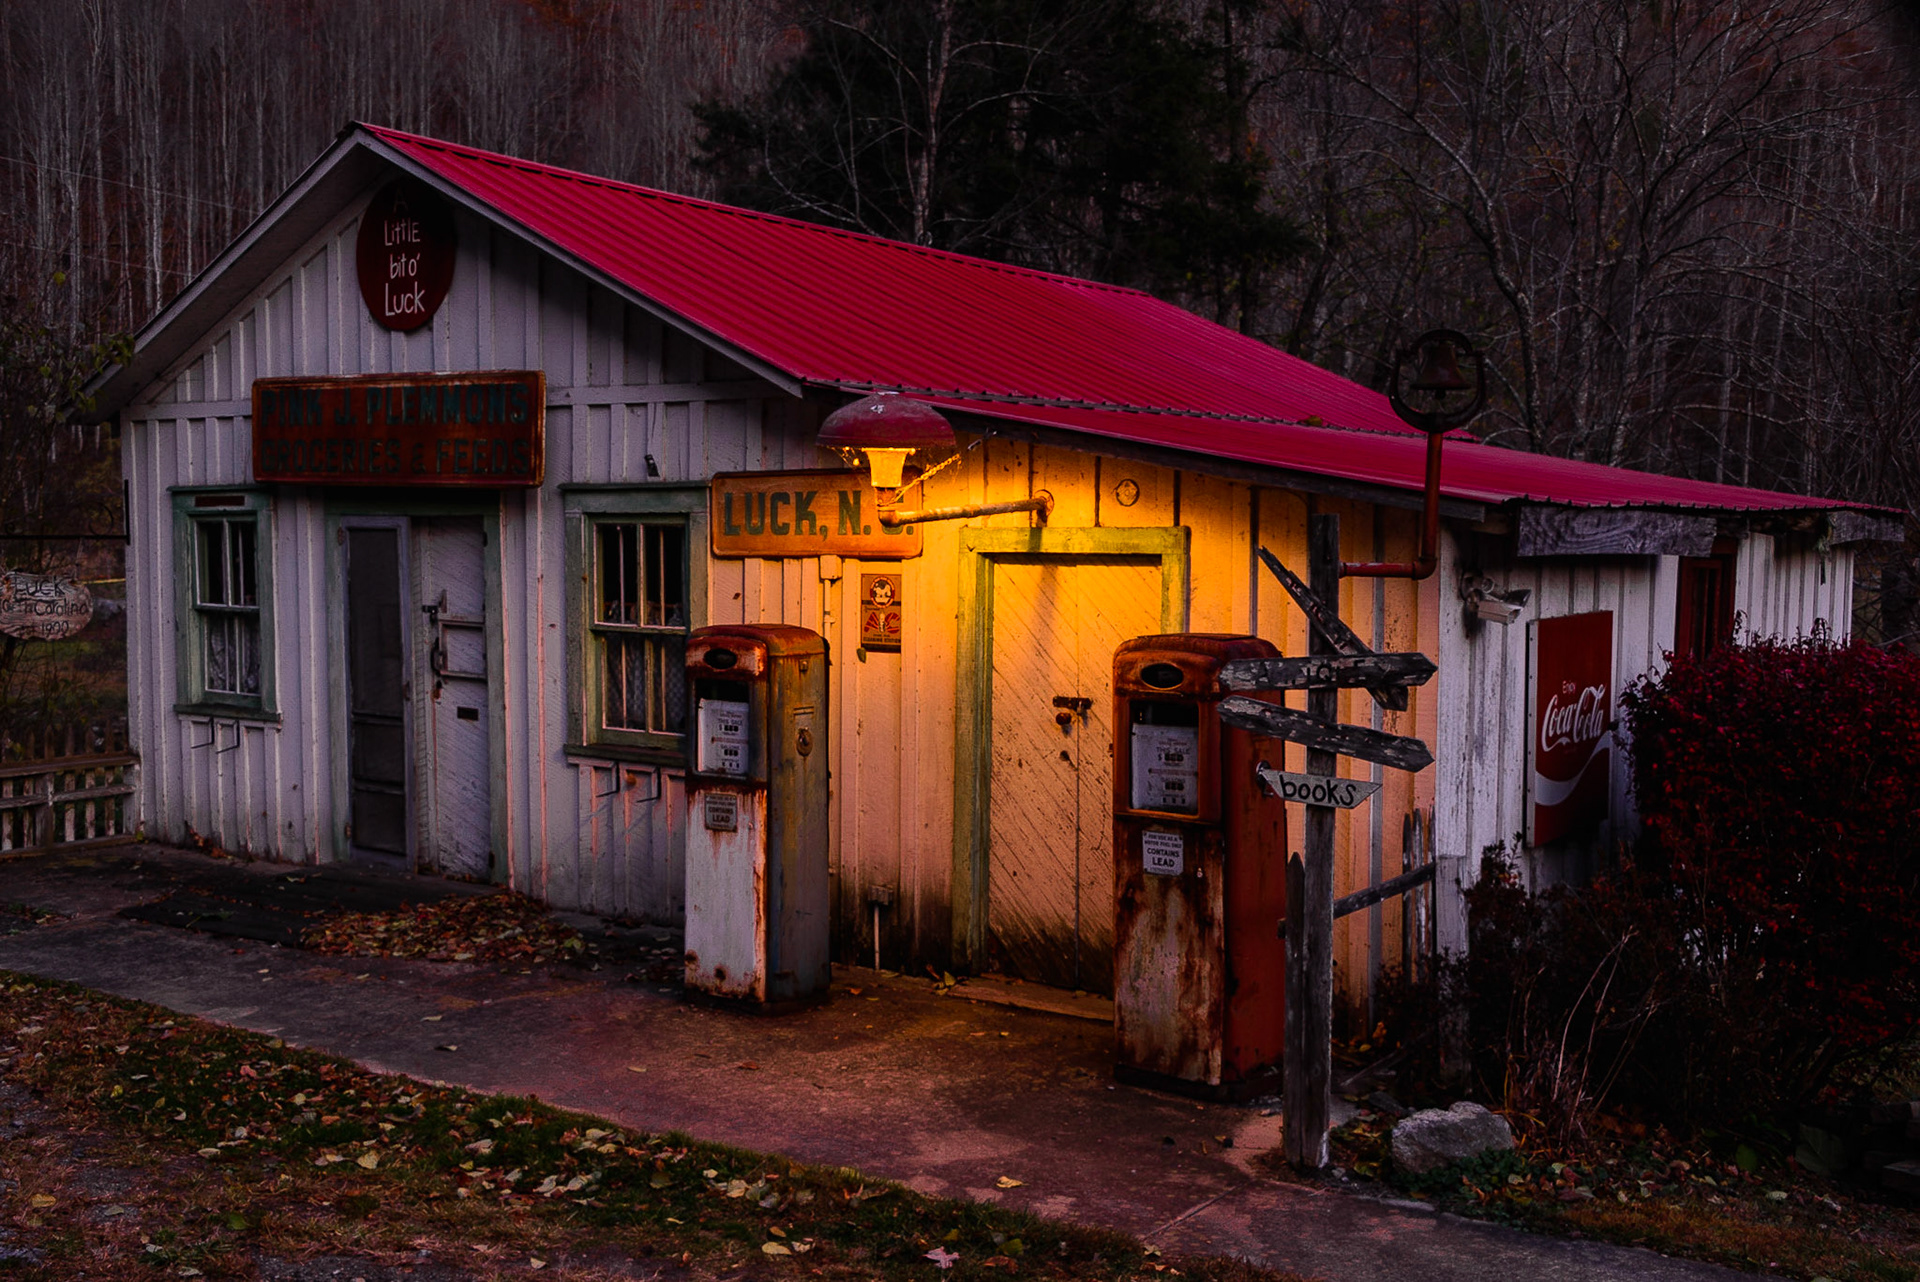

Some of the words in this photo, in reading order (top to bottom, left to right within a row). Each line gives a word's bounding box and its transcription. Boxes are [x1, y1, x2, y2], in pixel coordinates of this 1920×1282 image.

[385, 281, 426, 316] Luck
[262, 389, 322, 426] PINK
[334, 389, 357, 425] J.
[367, 383, 529, 425] PLEMMONS
[262, 439, 401, 473] GROCERIES
[411, 444, 426, 473] &
[436, 438, 530, 475] FEEDS
[724, 490, 828, 541] LUCK,
[1541, 684, 1605, 752] Coca-Cola
[1279, 774, 1357, 807] books
[1152, 856, 1175, 867] LEAD
